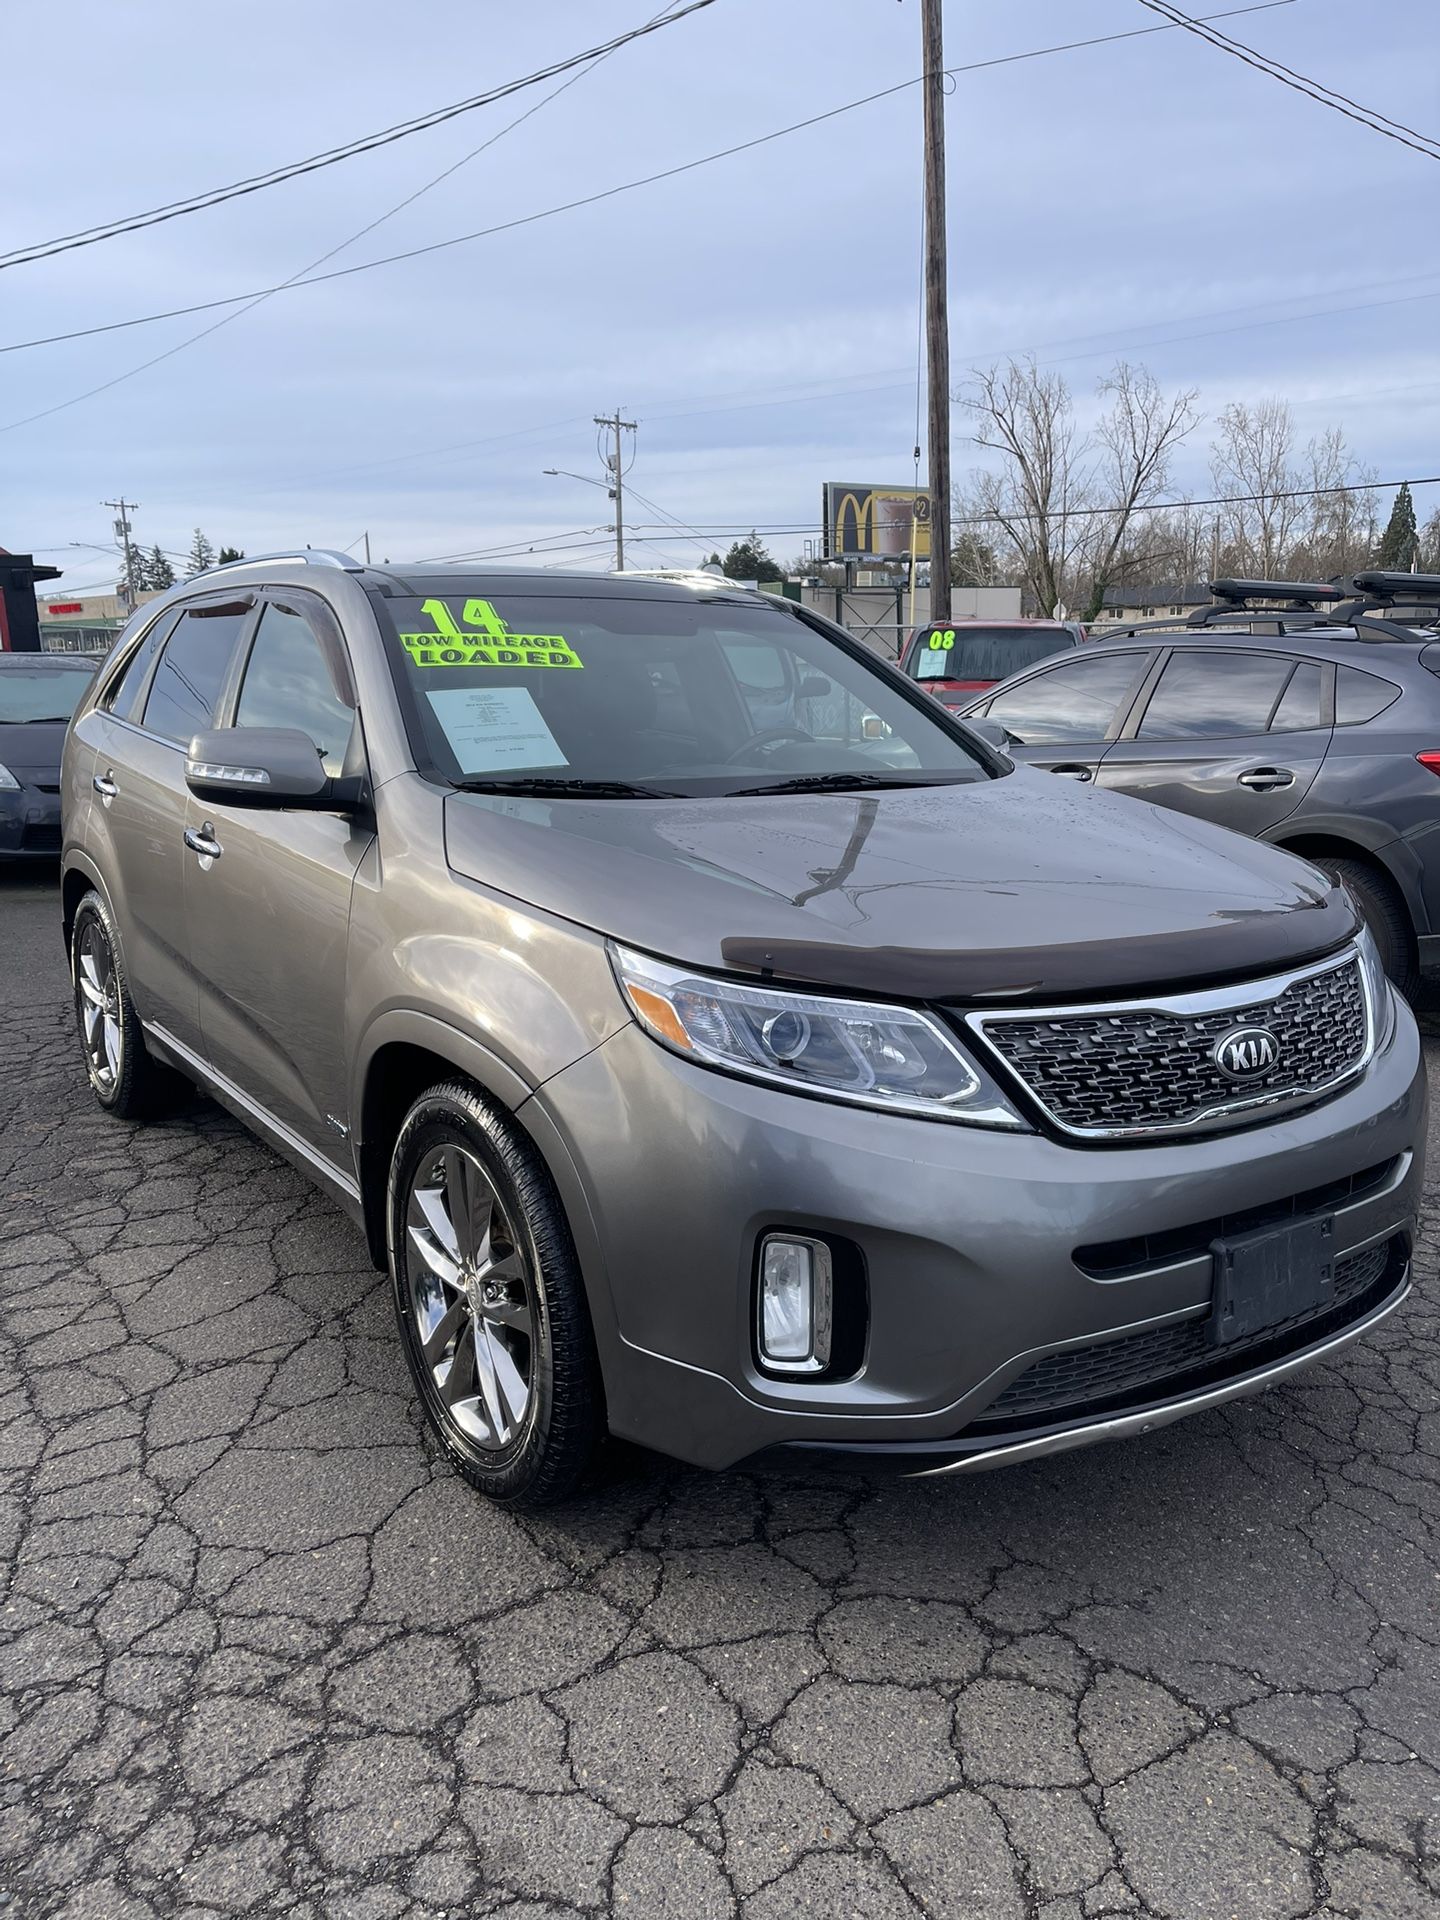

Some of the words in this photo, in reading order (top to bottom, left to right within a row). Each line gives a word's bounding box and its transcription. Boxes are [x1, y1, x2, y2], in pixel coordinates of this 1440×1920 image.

[915, 500, 926, 517] $2
[420, 598, 508, 635] 14
[404, 635, 451, 647] LOW
[463, 636, 563, 648] MILEAGE
[929, 630, 956, 650] 08
[419, 649, 571, 664] LOADED
[1229, 1037, 1274, 1071] KIA
